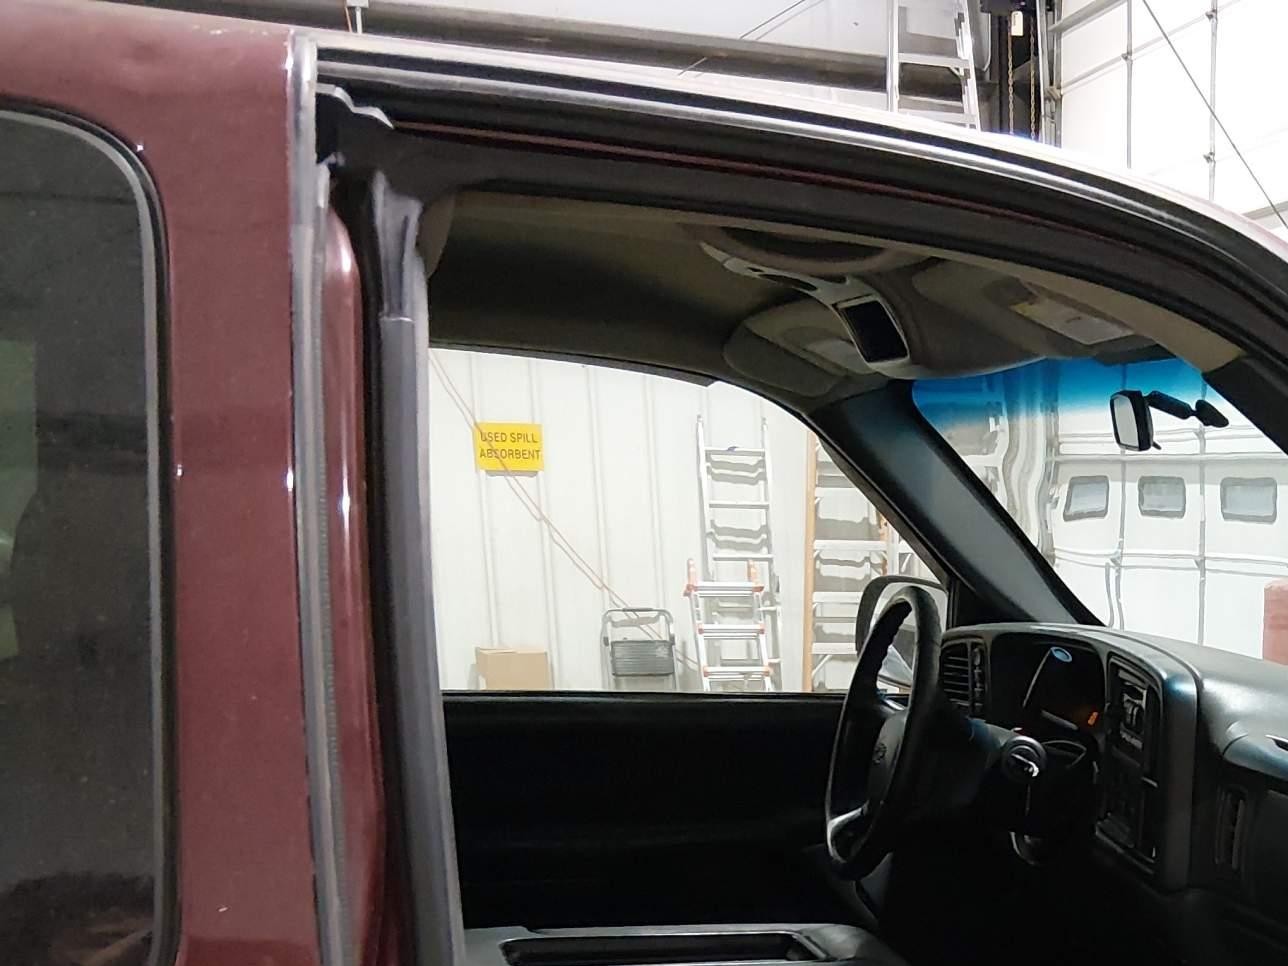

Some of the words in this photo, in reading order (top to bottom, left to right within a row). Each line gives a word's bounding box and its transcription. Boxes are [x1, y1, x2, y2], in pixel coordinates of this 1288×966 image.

[480, 432, 507, 443] USED
[510, 432, 539, 443] SPILL
[480, 448, 541, 460] ABSORBENT
